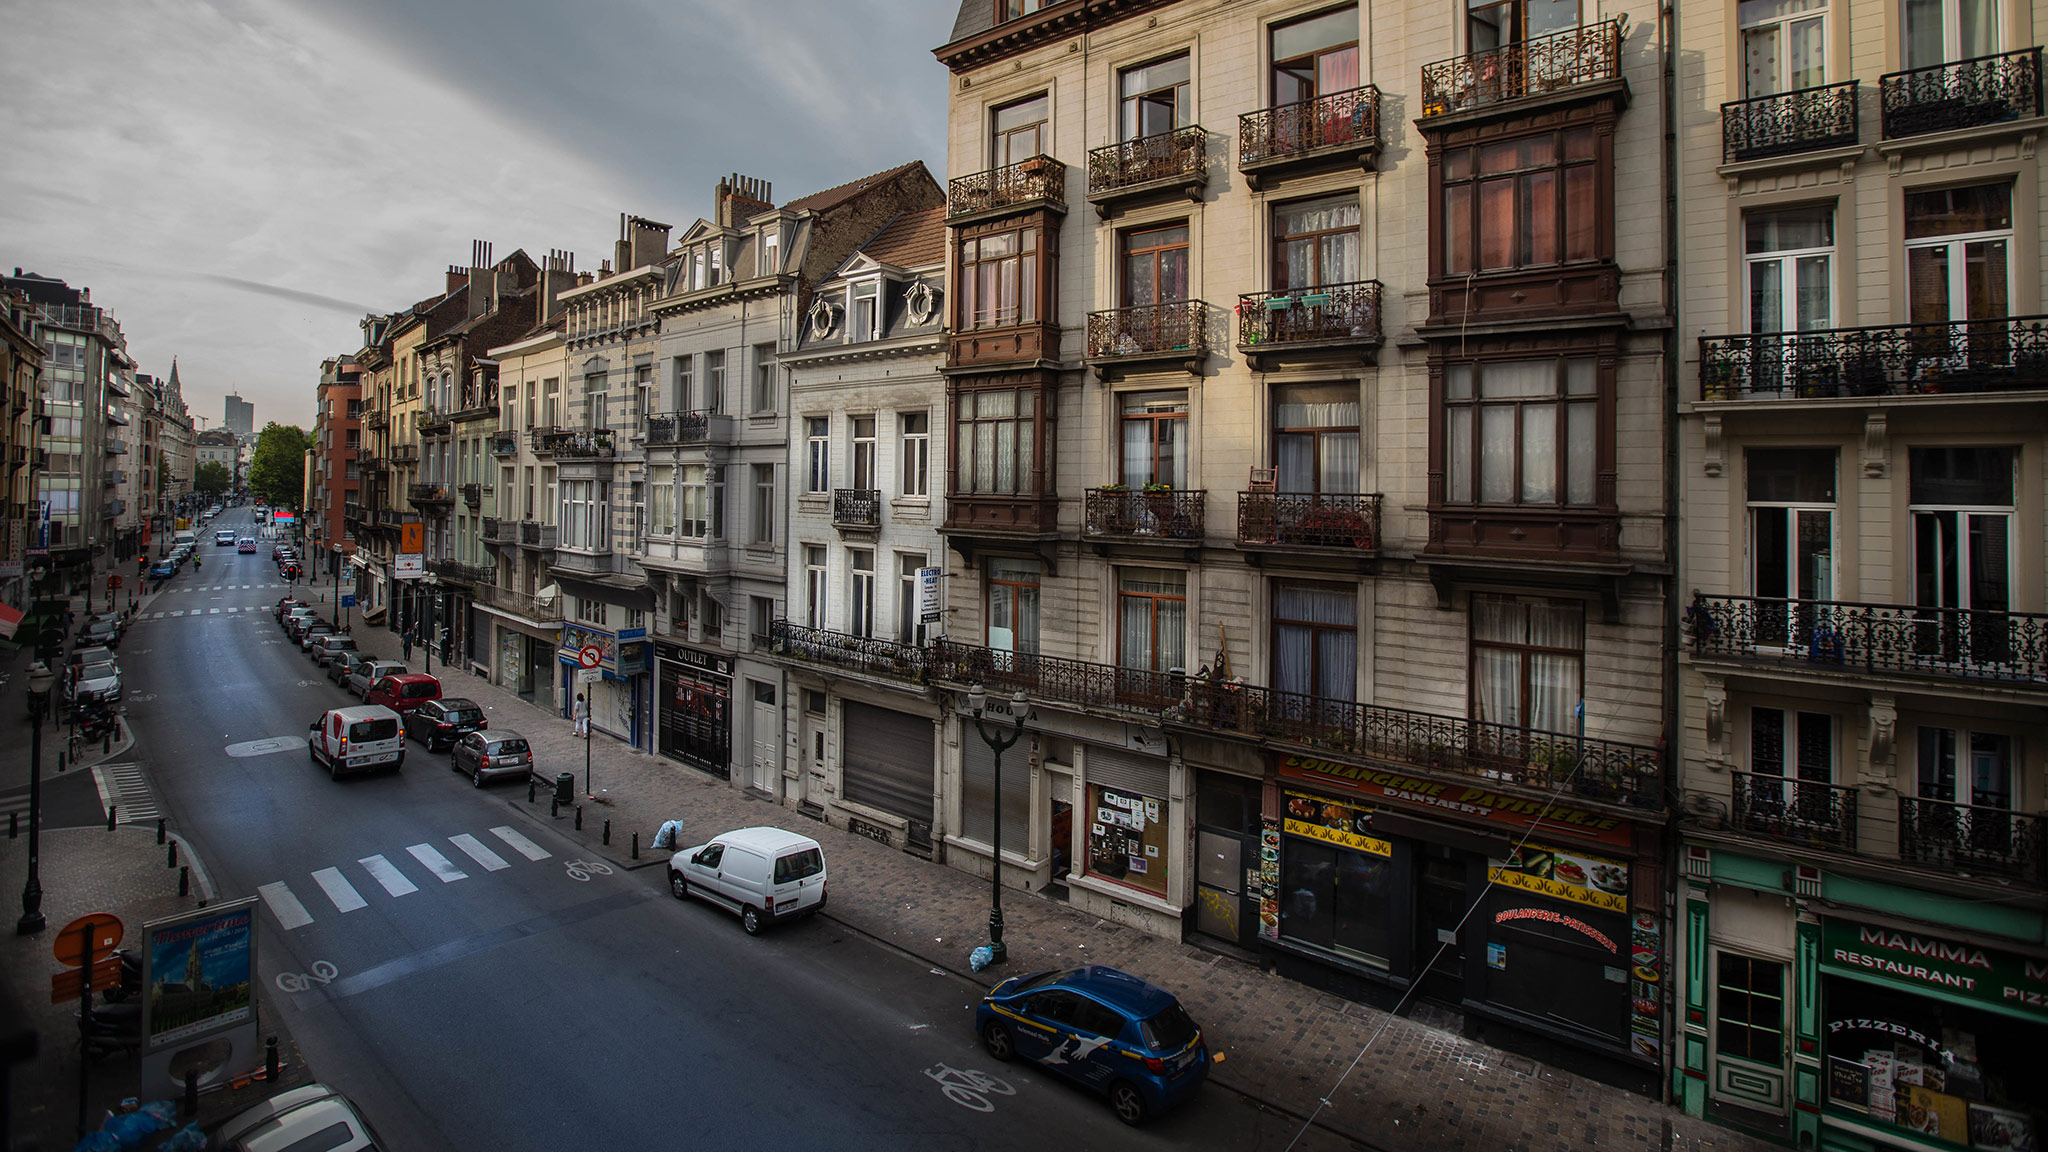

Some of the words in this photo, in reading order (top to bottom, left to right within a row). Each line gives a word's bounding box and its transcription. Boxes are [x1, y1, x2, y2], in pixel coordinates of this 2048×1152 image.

[921, 569, 940, 577] ELECTRO
[678, 648, 708, 666] OUTLET
[1285, 755, 1448, 797] BOULANGERIE
[1384, 787, 1492, 816] DANSAERT
[154, 915, 247, 946] Flowertime
[1860, 926, 1992, 970] MAMMA
[1834, 949, 1977, 990] RESTAURANT
[1828, 1018, 1955, 1065] PIZZERIA
